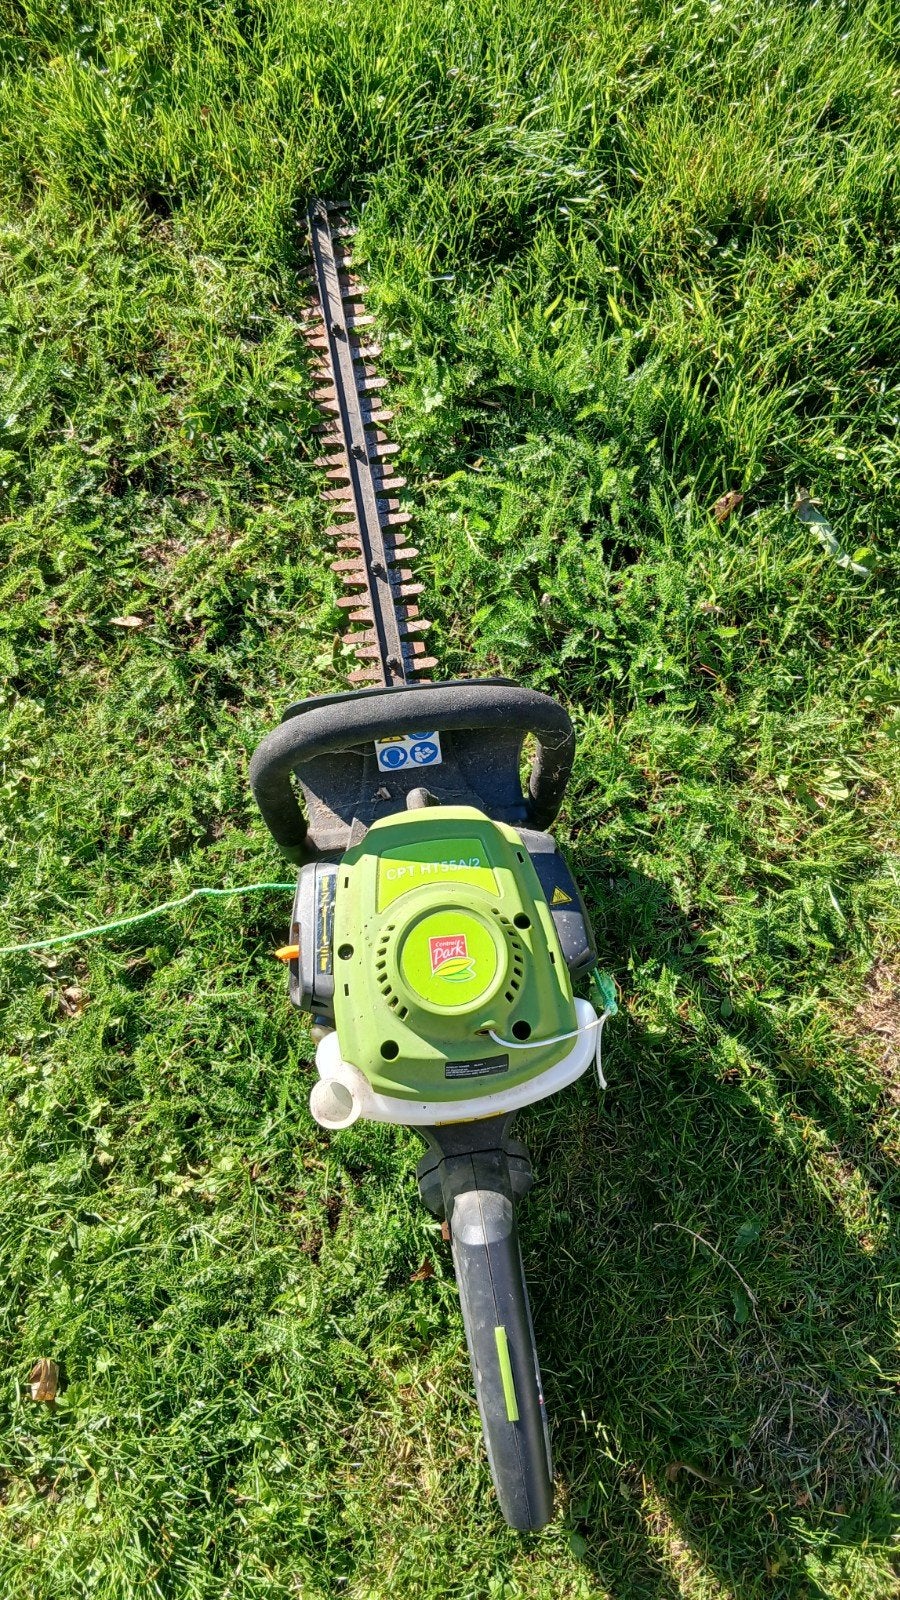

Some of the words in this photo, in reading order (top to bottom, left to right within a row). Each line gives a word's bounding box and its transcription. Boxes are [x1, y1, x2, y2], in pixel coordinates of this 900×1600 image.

[386, 865, 416, 880] CPT
[420, 858, 481, 875] HT55A/2
[433, 939, 466, 966] Park
[435, 940, 458, 948] Central
